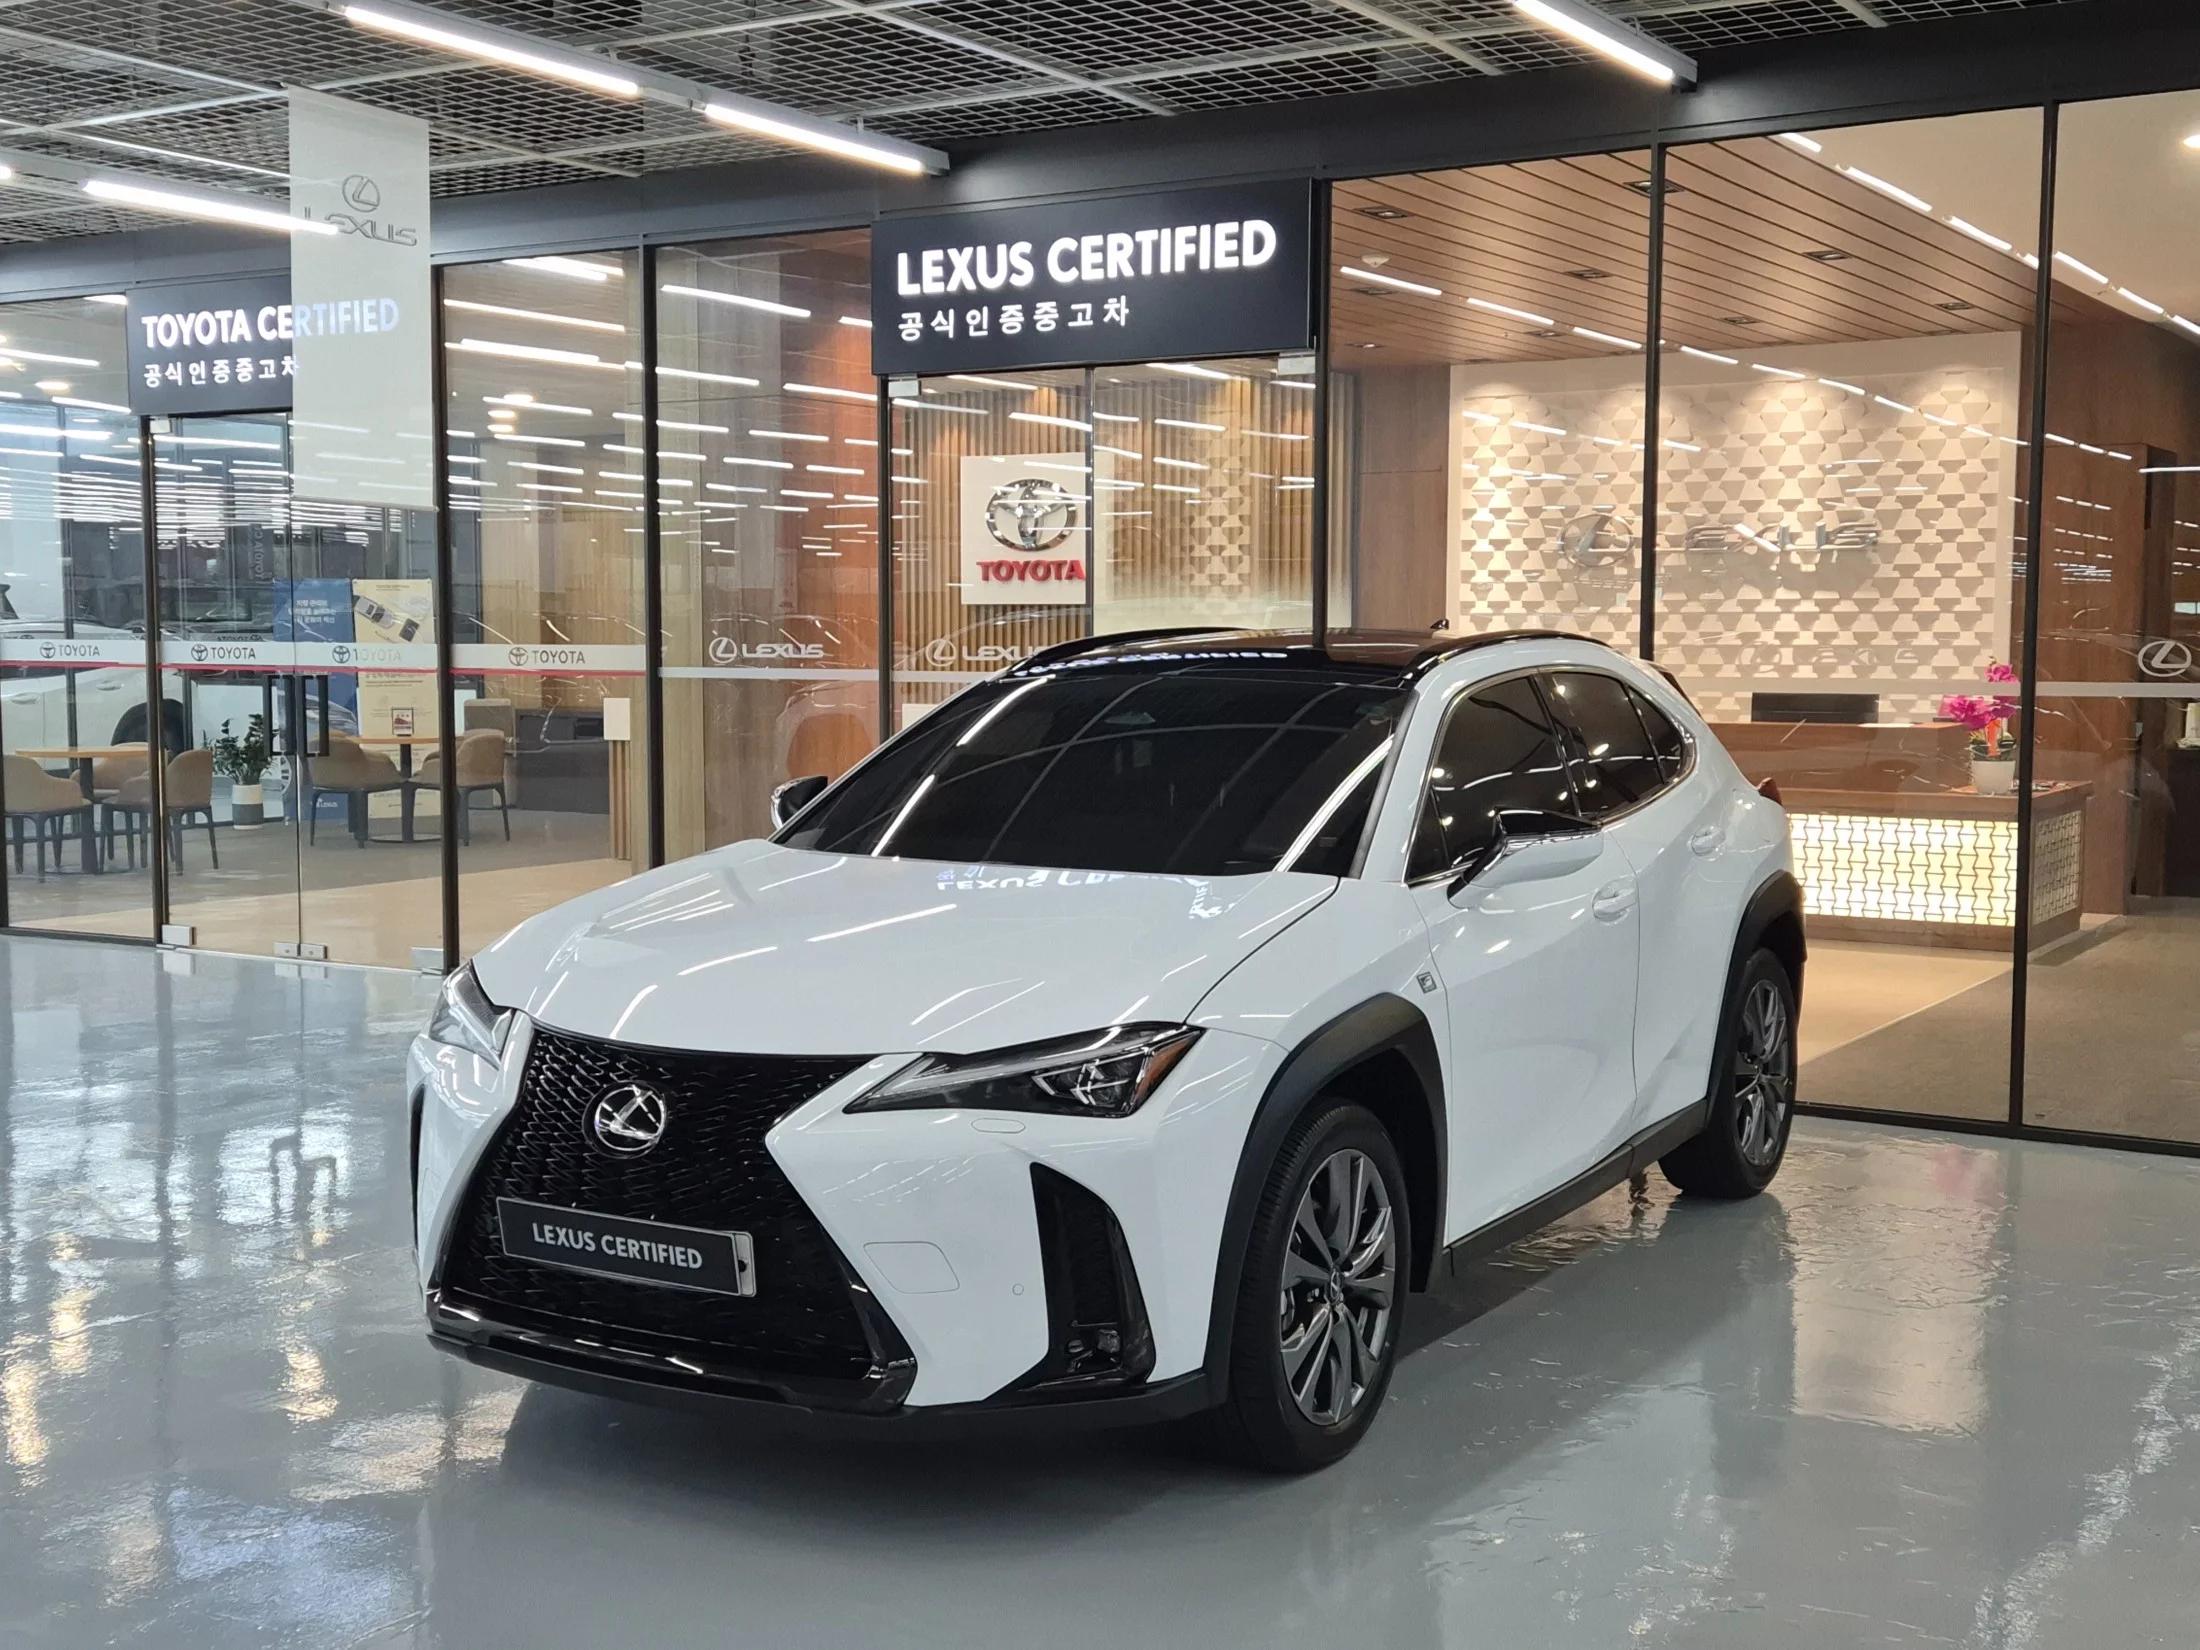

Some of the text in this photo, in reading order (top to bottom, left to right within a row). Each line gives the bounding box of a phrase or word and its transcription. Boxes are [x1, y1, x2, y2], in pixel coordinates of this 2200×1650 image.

[897, 218, 1278, 297] LEXUS CERTIFIED
[141, 298, 400, 349] TOYOTA CERTIFIED
[976, 559, 1087, 582] TOYOTA
[58, 644, 101, 657] TOYOTA
[211, 645, 257, 660] TOYOTA
[353, 648, 402, 662] TOYOTA
[532, 650, 586, 665] TOYOTA
[742, 643, 824, 660] LEXUS
[532, 1222, 703, 1270] LEXUS CERTIFIED
